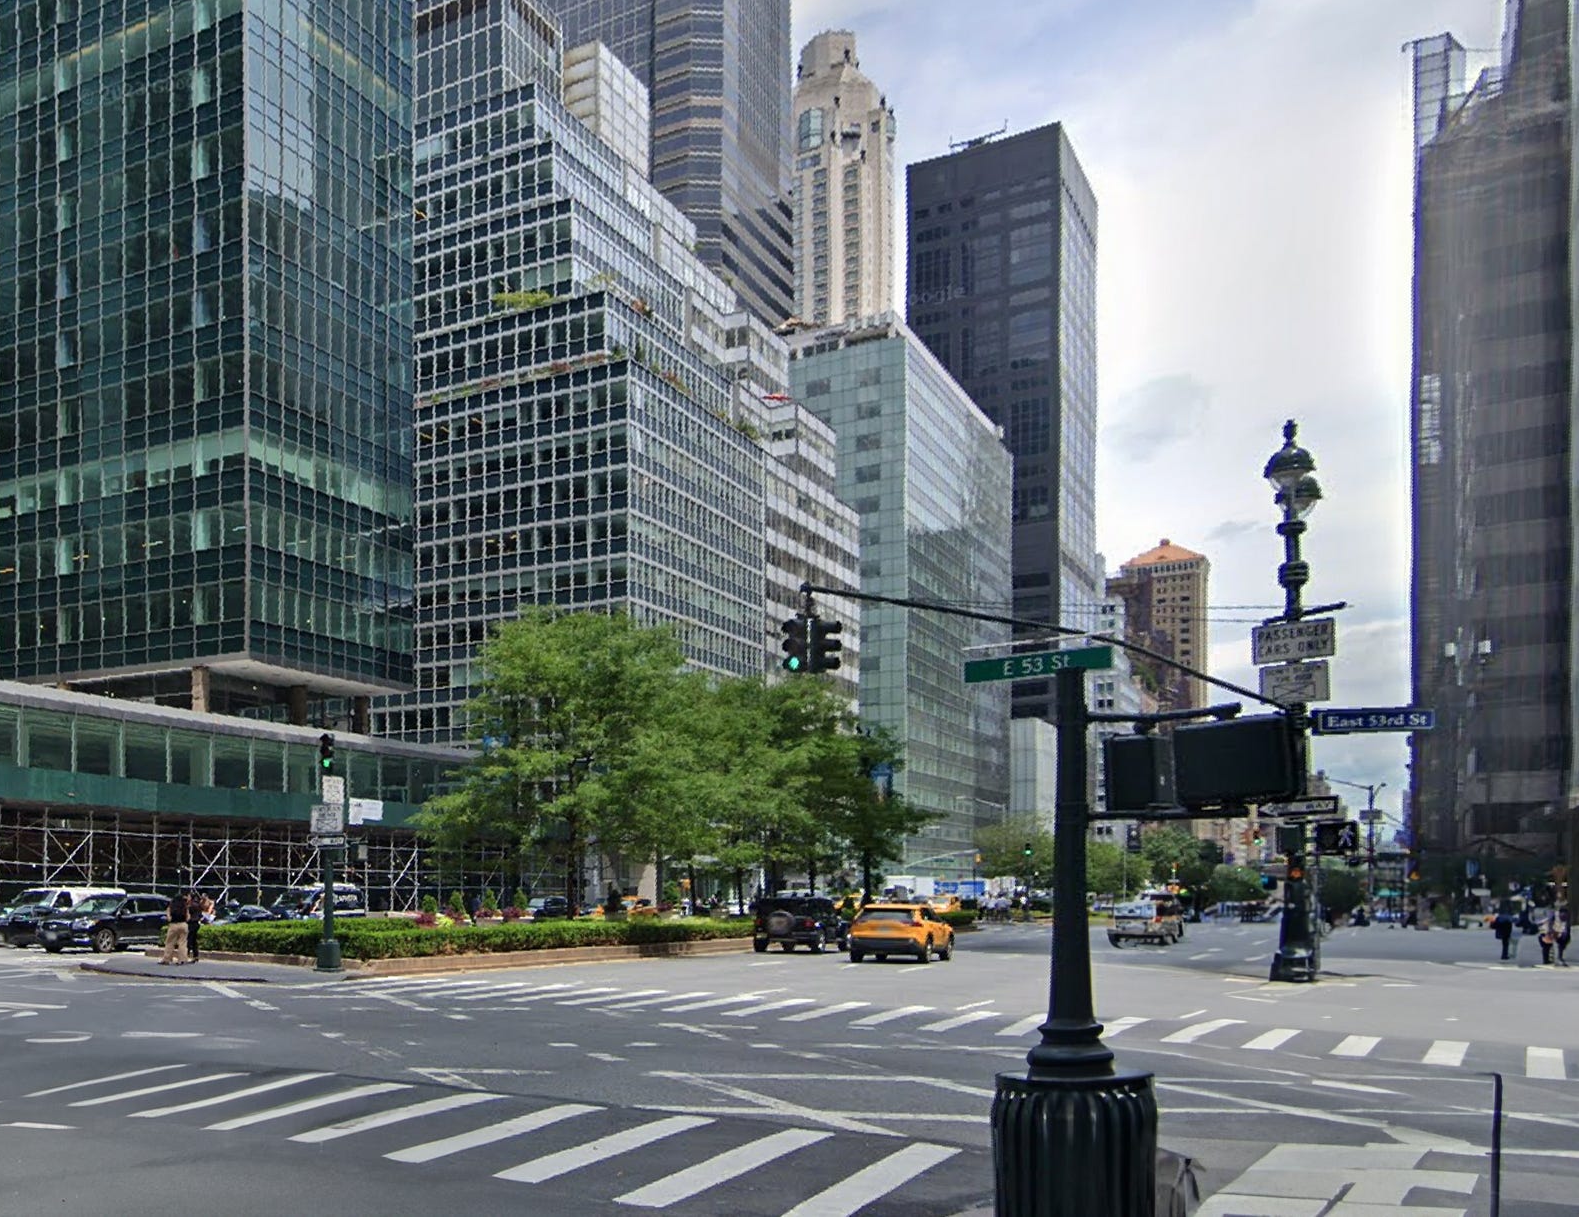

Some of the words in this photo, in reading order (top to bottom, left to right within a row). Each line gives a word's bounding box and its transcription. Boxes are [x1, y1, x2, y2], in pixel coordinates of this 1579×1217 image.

[1257, 624, 1328, 643] PASSENGER
[1258, 643, 1290, 658] CARS
[1298, 638, 1329, 652] ONLY
[1003, 661, 1014, 676] E
[1021, 658, 1044, 674] 53
[1051, 654, 1071, 669] St
[1327, 715, 1364, 728] East
[1368, 713, 1406, 727] 53rd
[1409, 713, 1428, 726] St
